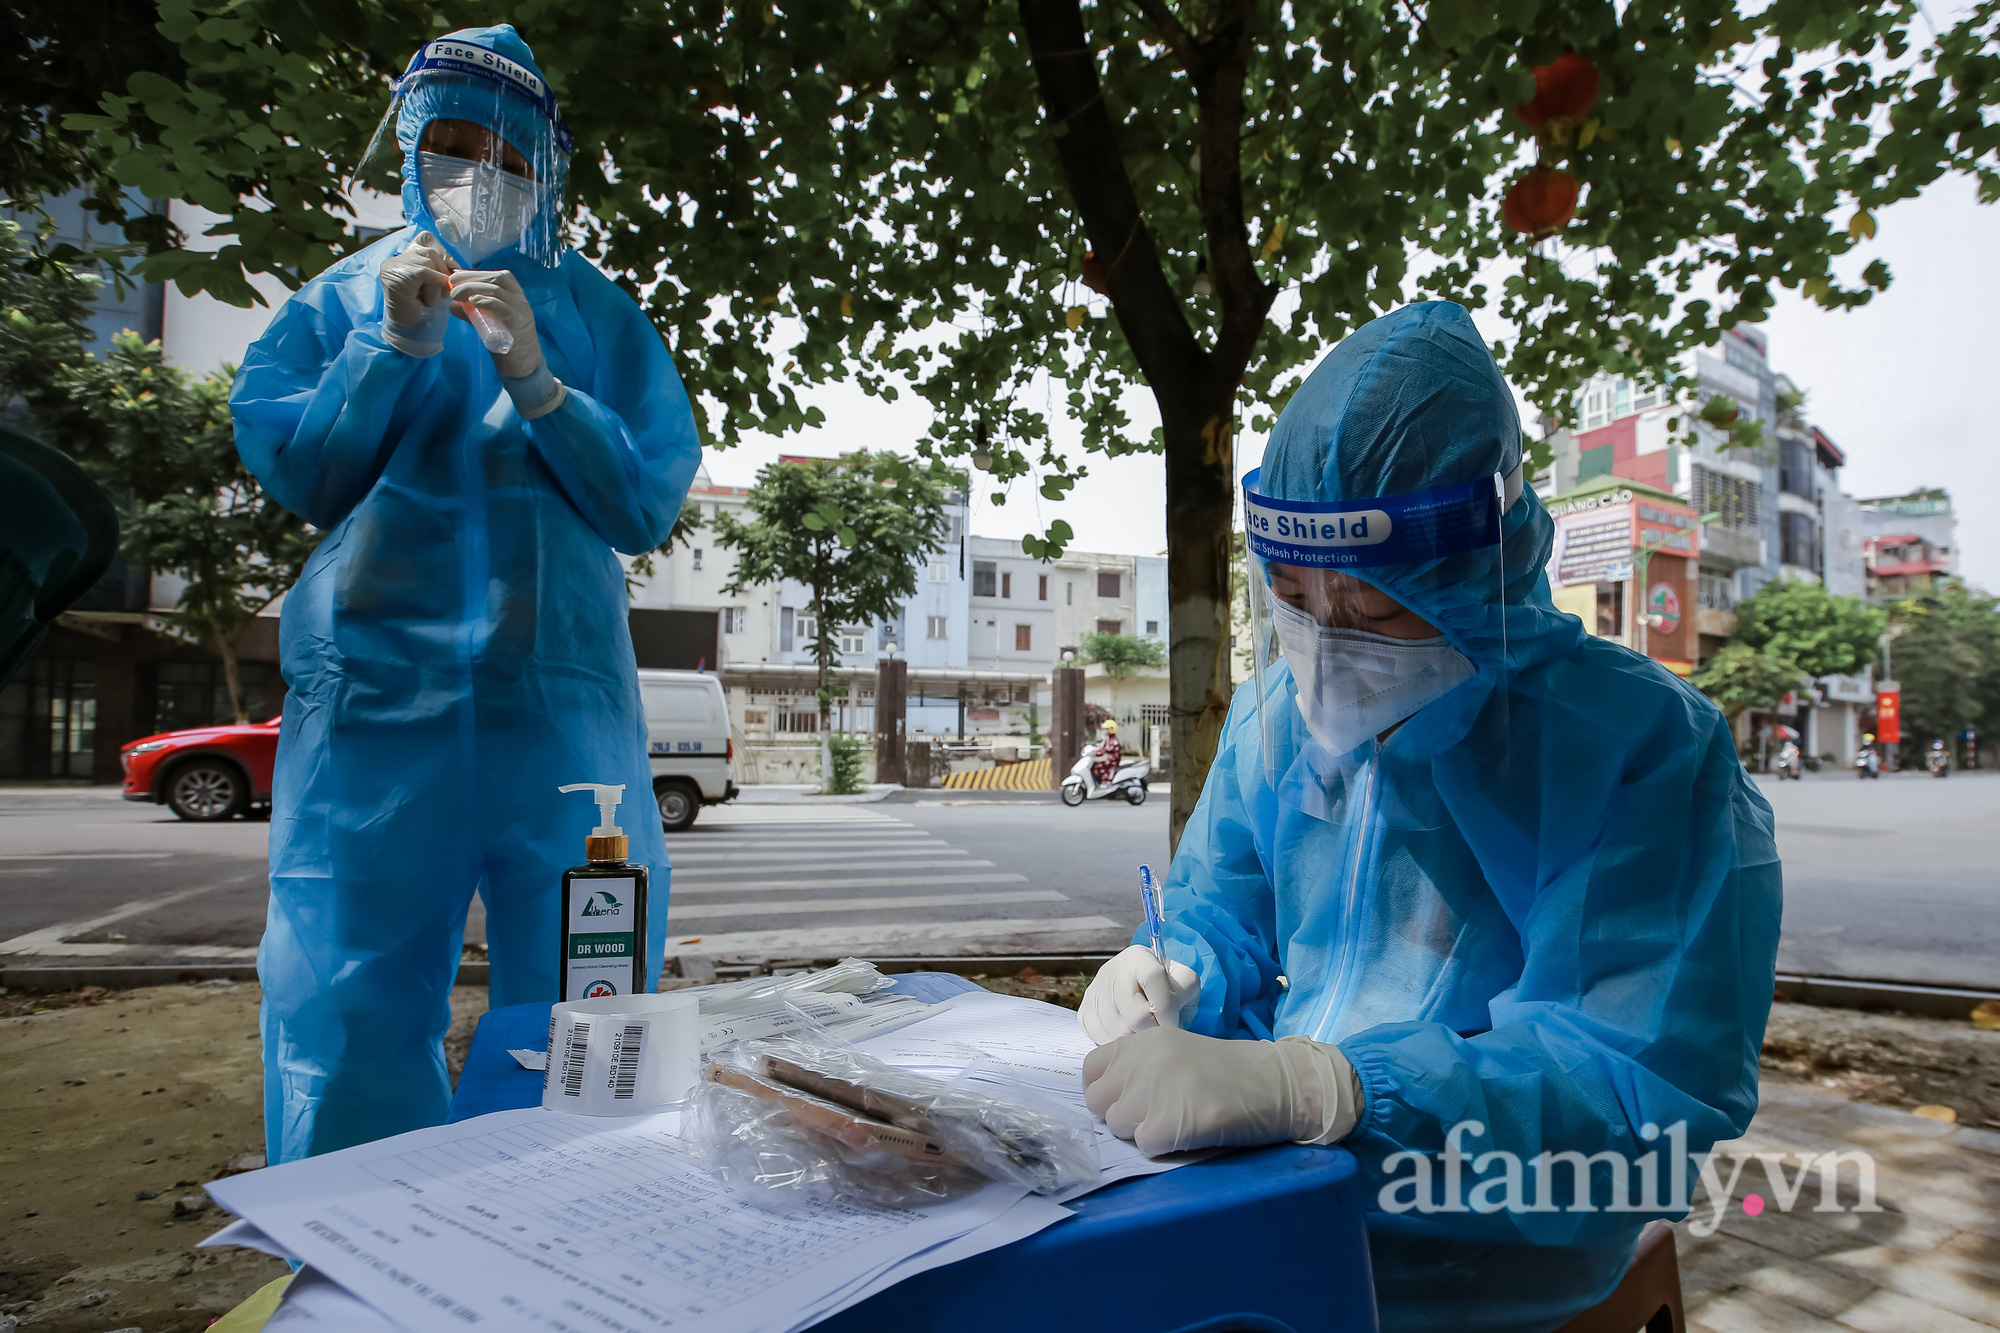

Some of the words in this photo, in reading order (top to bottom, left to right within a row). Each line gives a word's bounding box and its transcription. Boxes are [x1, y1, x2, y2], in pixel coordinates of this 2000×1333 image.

[434, 44, 475, 60] Face
[482, 53, 539, 90] Shield
[437, 60, 461, 70] Direct
[462, 64, 491, 79] Splash
[1599, 488, 1633, 509] CÁO
[1247, 510, 1270, 532] ace
[1276, 515, 1369, 540] Shield
[1262, 544, 1291, 560] Splash
[1293, 549, 1358, 564] Protection
[577, 944, 591, 954] DR
[594, 943, 625, 954] WOOD
